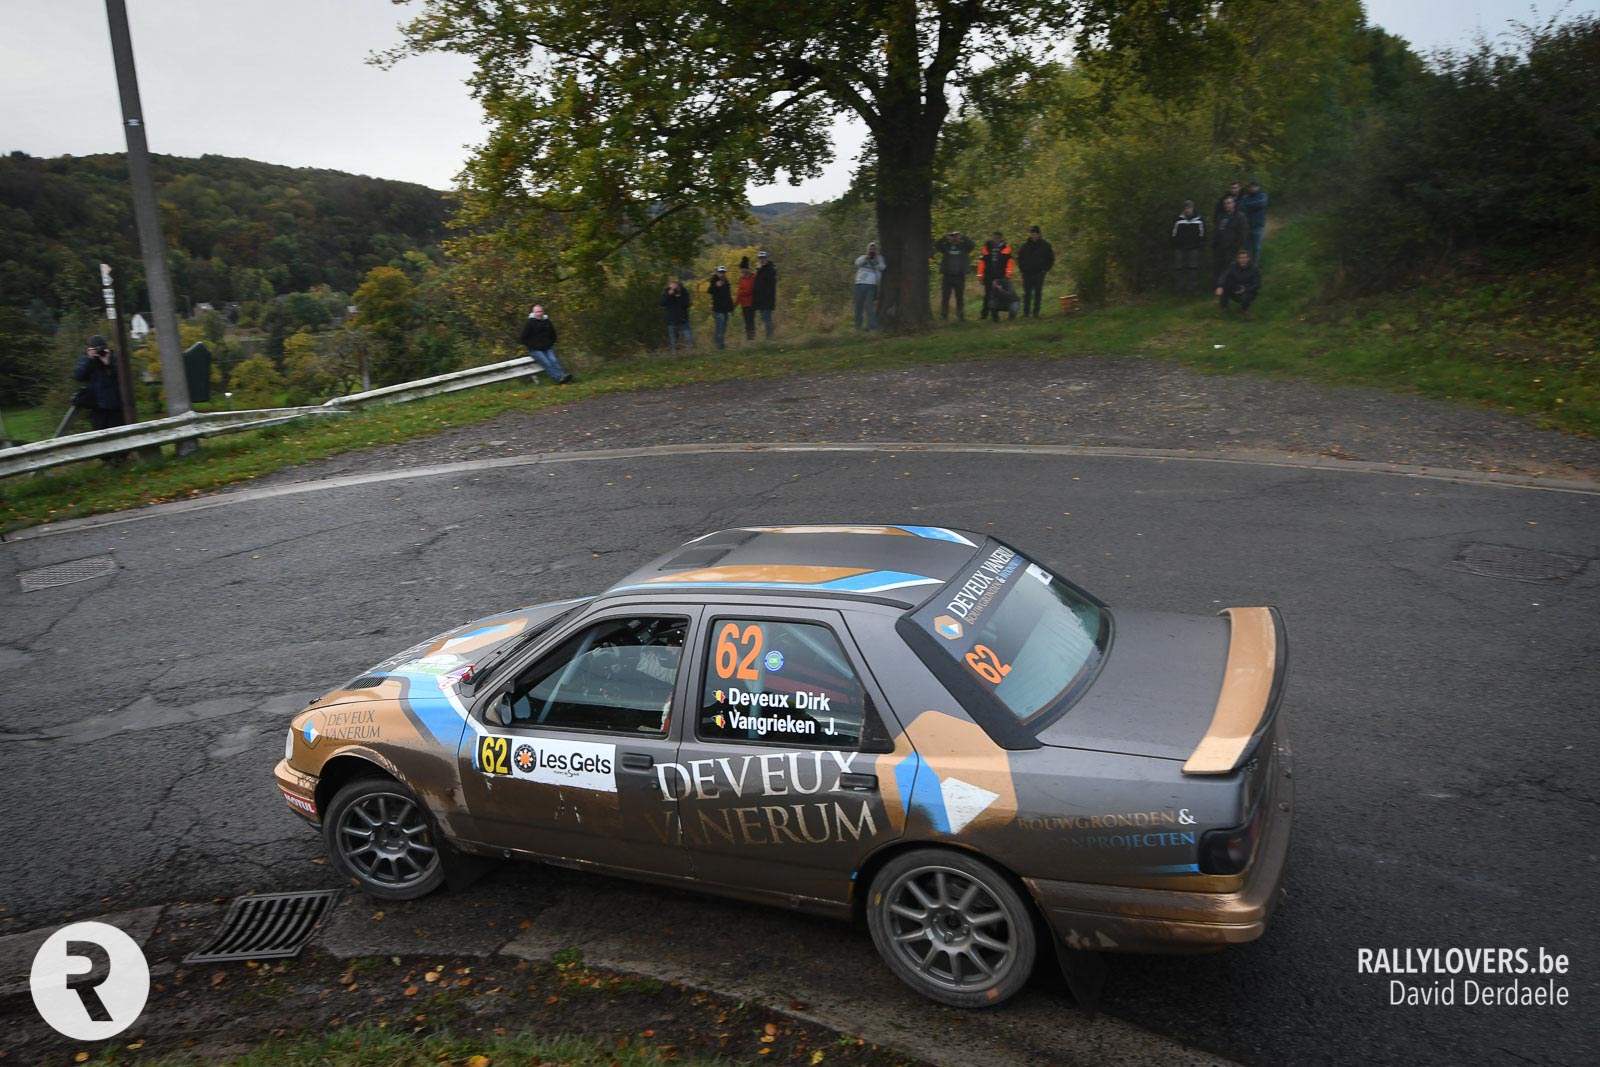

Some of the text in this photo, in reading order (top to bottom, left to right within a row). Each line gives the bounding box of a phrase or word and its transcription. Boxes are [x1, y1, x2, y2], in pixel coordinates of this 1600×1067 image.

[946, 570, 994, 618] DEVEUX
[715, 623, 763, 680] 62
[965, 644, 1012, 684] 62
[327, 709, 375, 727] DEVEUX
[728, 687, 830, 711] Deveux Dirk
[324, 725, 380, 741] VANERUM
[728, 710, 839, 735] Vangrieken J.
[481, 736, 509, 774] 62
[653, 751, 867, 802] DEVEUX
